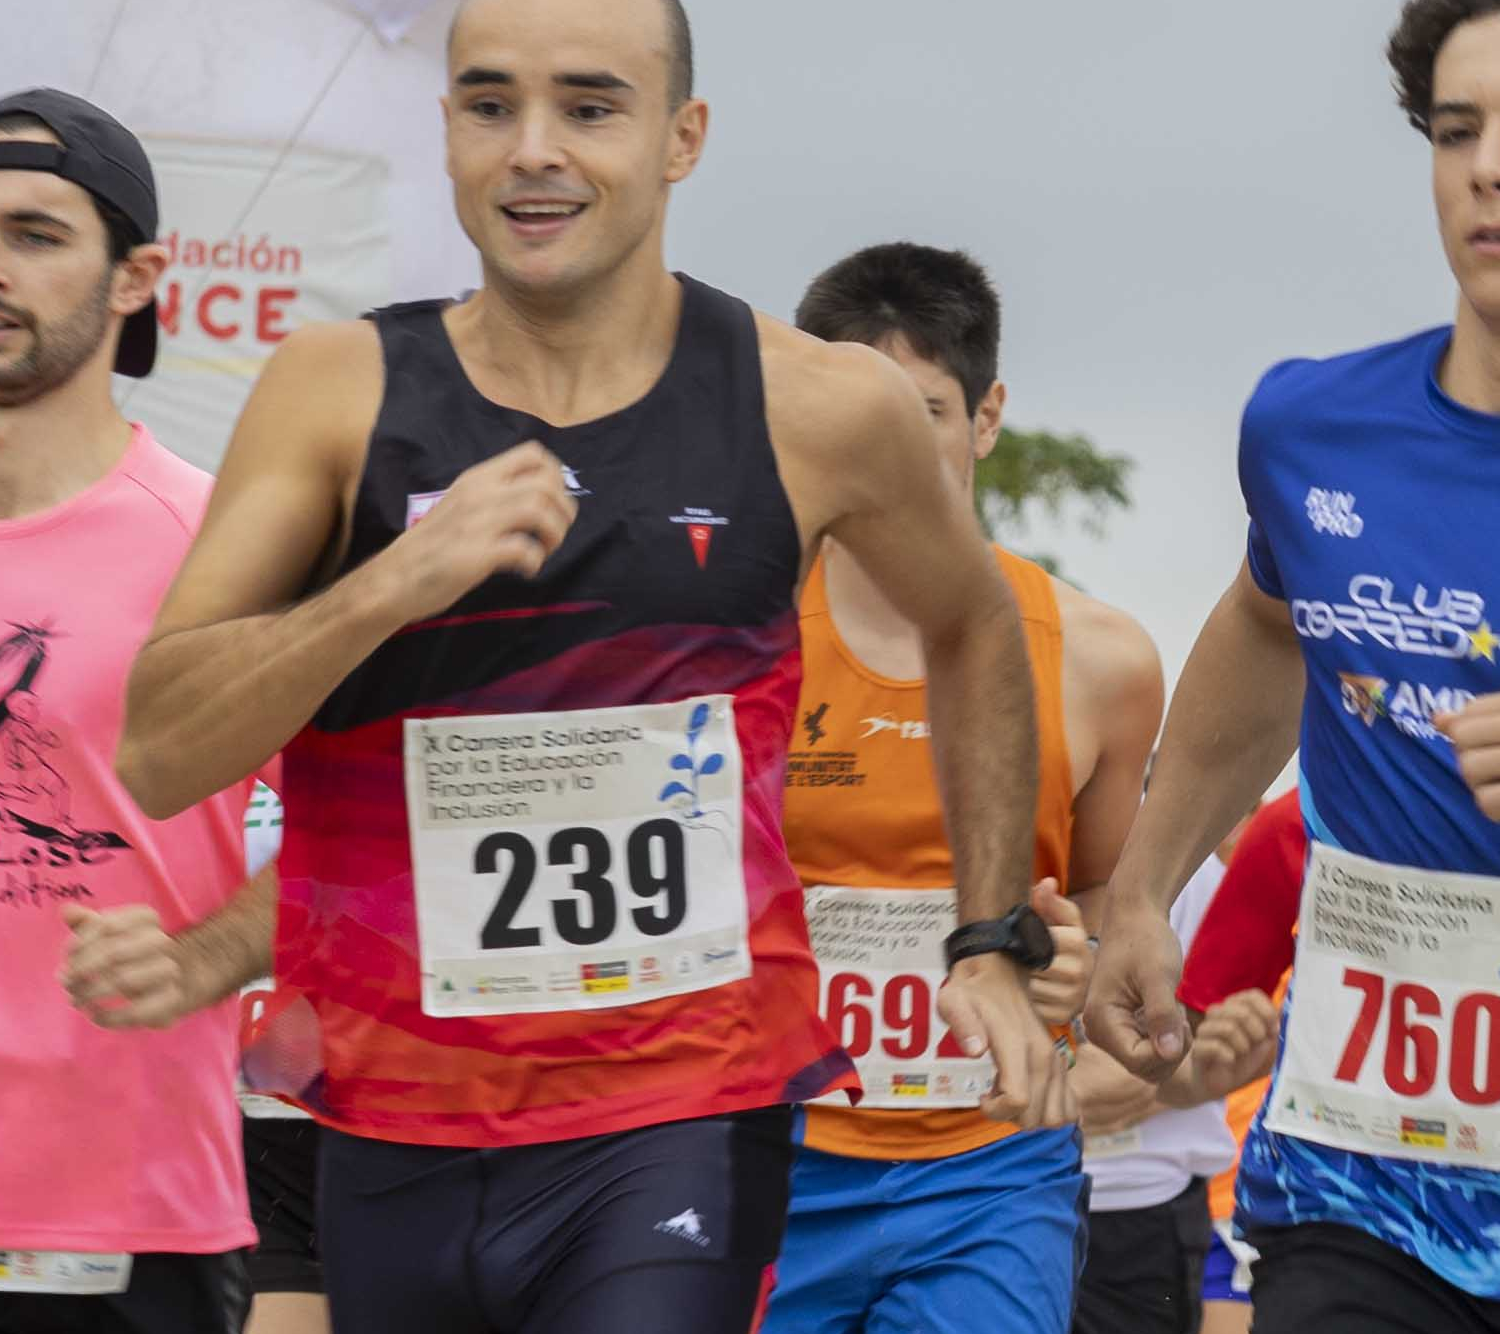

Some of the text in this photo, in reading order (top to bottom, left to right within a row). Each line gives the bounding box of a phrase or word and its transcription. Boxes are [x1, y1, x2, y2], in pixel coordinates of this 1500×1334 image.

[161, 230, 302, 275] dación
[156, 280, 300, 344] NCE
[1348, 573, 1485, 625] CLUB
[446, 733, 535, 753] Carrera
[541, 724, 643, 747] Solidaria
[473, 818, 689, 950] 239
